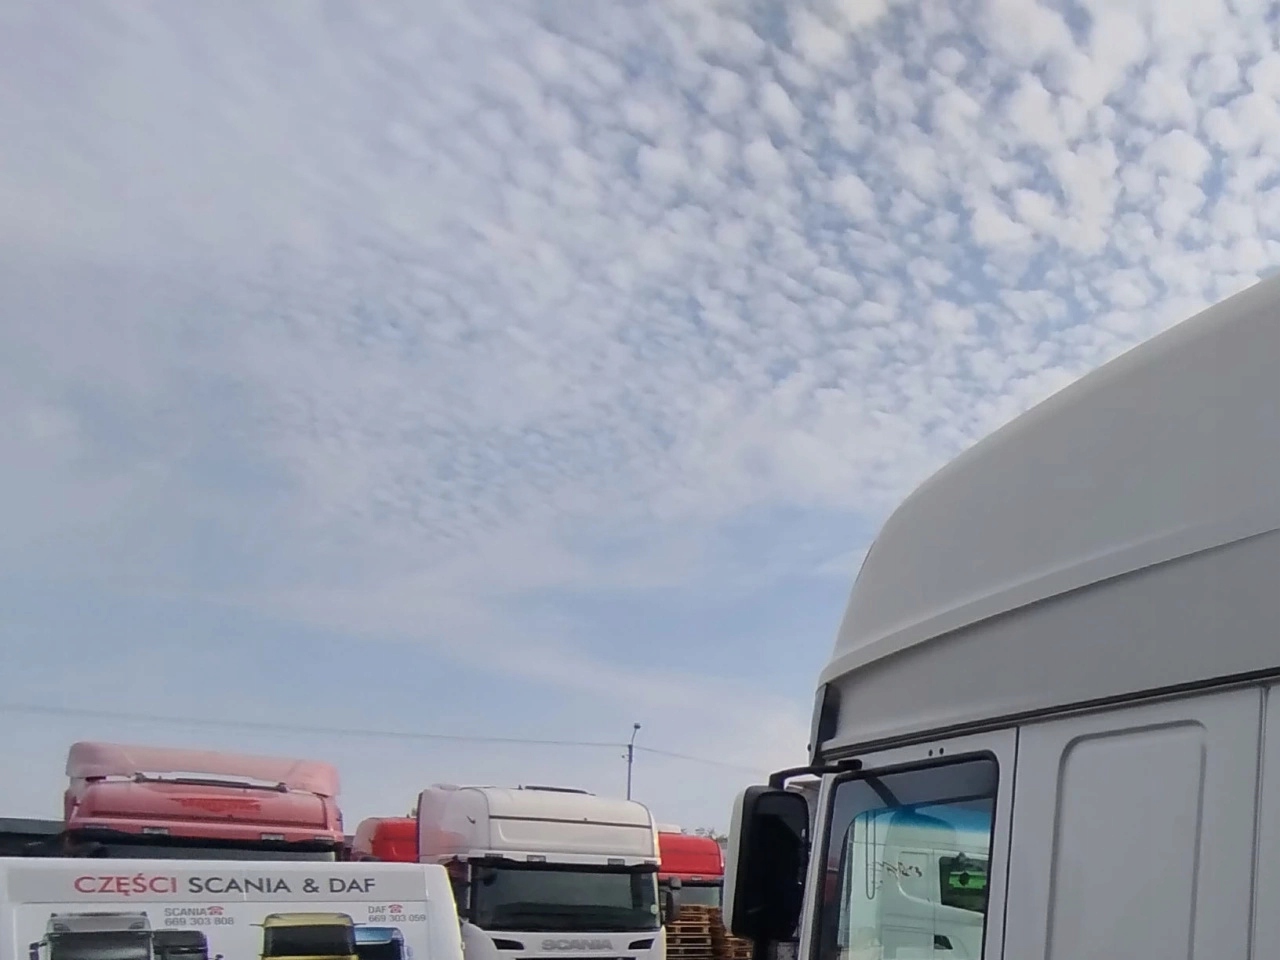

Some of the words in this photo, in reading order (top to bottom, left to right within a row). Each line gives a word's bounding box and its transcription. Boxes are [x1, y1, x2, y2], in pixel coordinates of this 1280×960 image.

[74, 873, 177, 896] CZĘŚCI
[188, 877, 291, 893] SCANIA
[302, 878, 320, 893] &
[329, 878, 376, 893] DAF
[164, 907, 207, 916] SCANIA
[368, 905, 386, 914] DAF
[190, 917, 211, 925] 303
[541, 939, 613, 950] SCANIA
